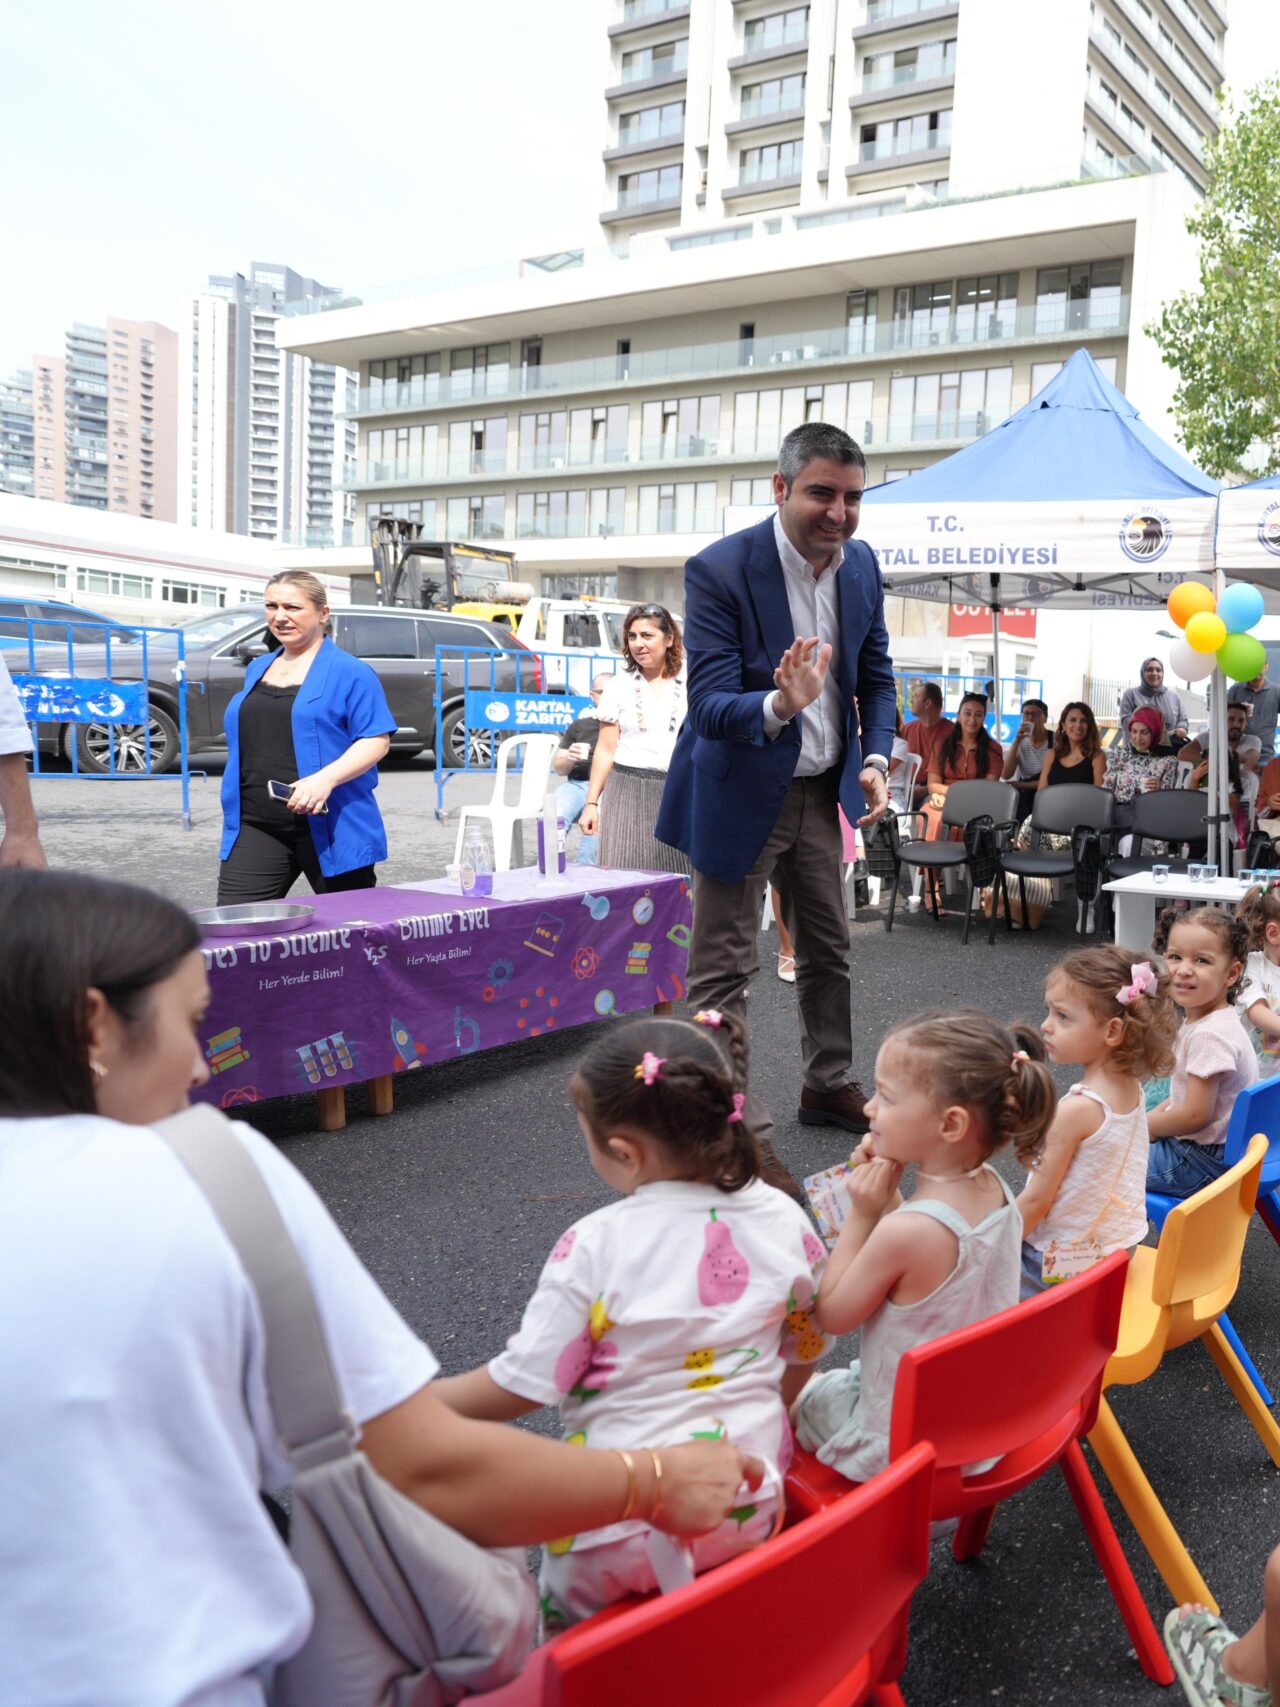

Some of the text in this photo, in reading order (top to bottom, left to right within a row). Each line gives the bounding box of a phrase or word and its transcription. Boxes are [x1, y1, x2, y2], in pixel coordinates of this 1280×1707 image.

[926, 514, 965, 532] T.C.
[876, 543, 1058, 565] RTAL BELEDİYESİ
[515, 699, 575, 713] KARTAL
[515, 712, 574, 725] ZABITA
[407, 956, 424, 966] Her
[448, 946, 472, 960] Bilim!
[259, 966, 344, 991] Her Yerde Bilim!
